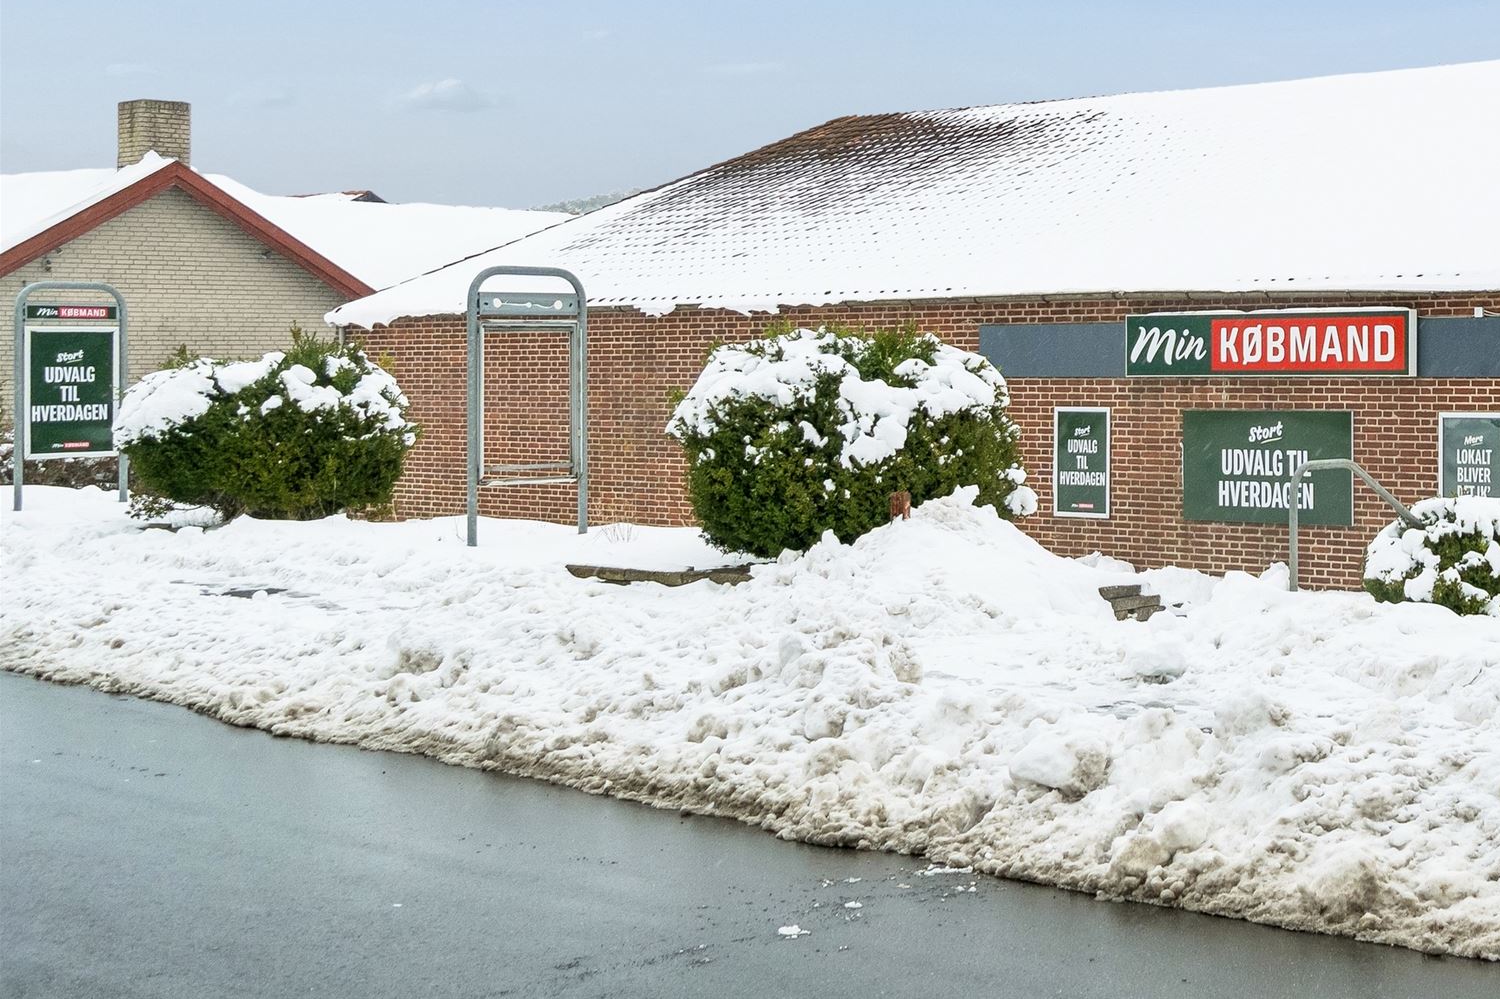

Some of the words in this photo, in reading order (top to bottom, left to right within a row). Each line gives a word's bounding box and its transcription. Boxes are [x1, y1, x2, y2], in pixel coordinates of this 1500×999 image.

[36, 308, 58, 316] Min
[61, 308, 106, 317] KØBMAND
[1130, 326, 1206, 365] Min
[1220, 324, 1395, 365] KØBMAND
[56, 349, 84, 363] Stort
[44, 366, 96, 383] UDVALG
[60, 385, 81, 402] TIL
[31, 404, 108, 422] HVERDAGEN
[1074, 425, 1091, 436] Stort
[1248, 421, 1283, 442] Stort
[1067, 439, 1098, 454] UDVALG
[1463, 435, 1484, 446] Mere
[1076, 455, 1088, 470] TIL
[1221, 449, 1283, 476] UDVALG
[1457, 449, 1492, 464] LOKALT
[1060, 471, 1105, 486] HVERDAGEN
[1457, 467, 1491, 483] BLIVER
